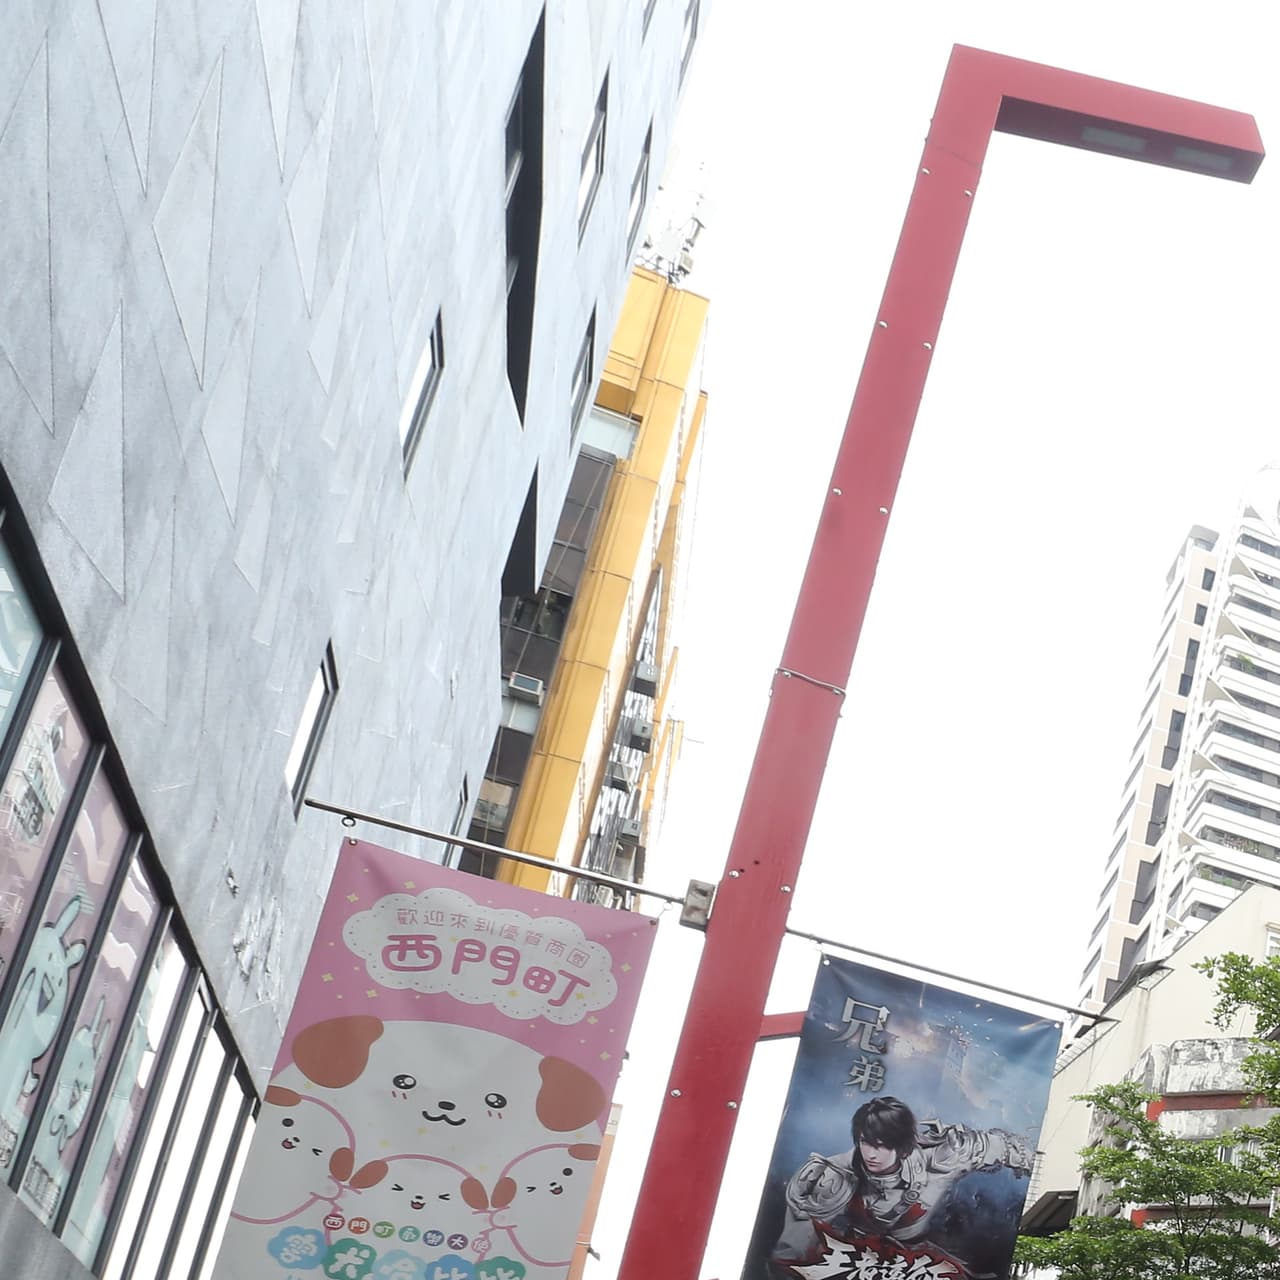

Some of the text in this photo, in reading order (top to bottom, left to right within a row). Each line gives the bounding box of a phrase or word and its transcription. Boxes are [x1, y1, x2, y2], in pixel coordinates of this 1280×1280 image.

[381, 934, 591, 1007] 西門町
[397, 908, 591, 968] 歡迎來到優質商圈
[832, 997, 891, 1092] 兄弟
